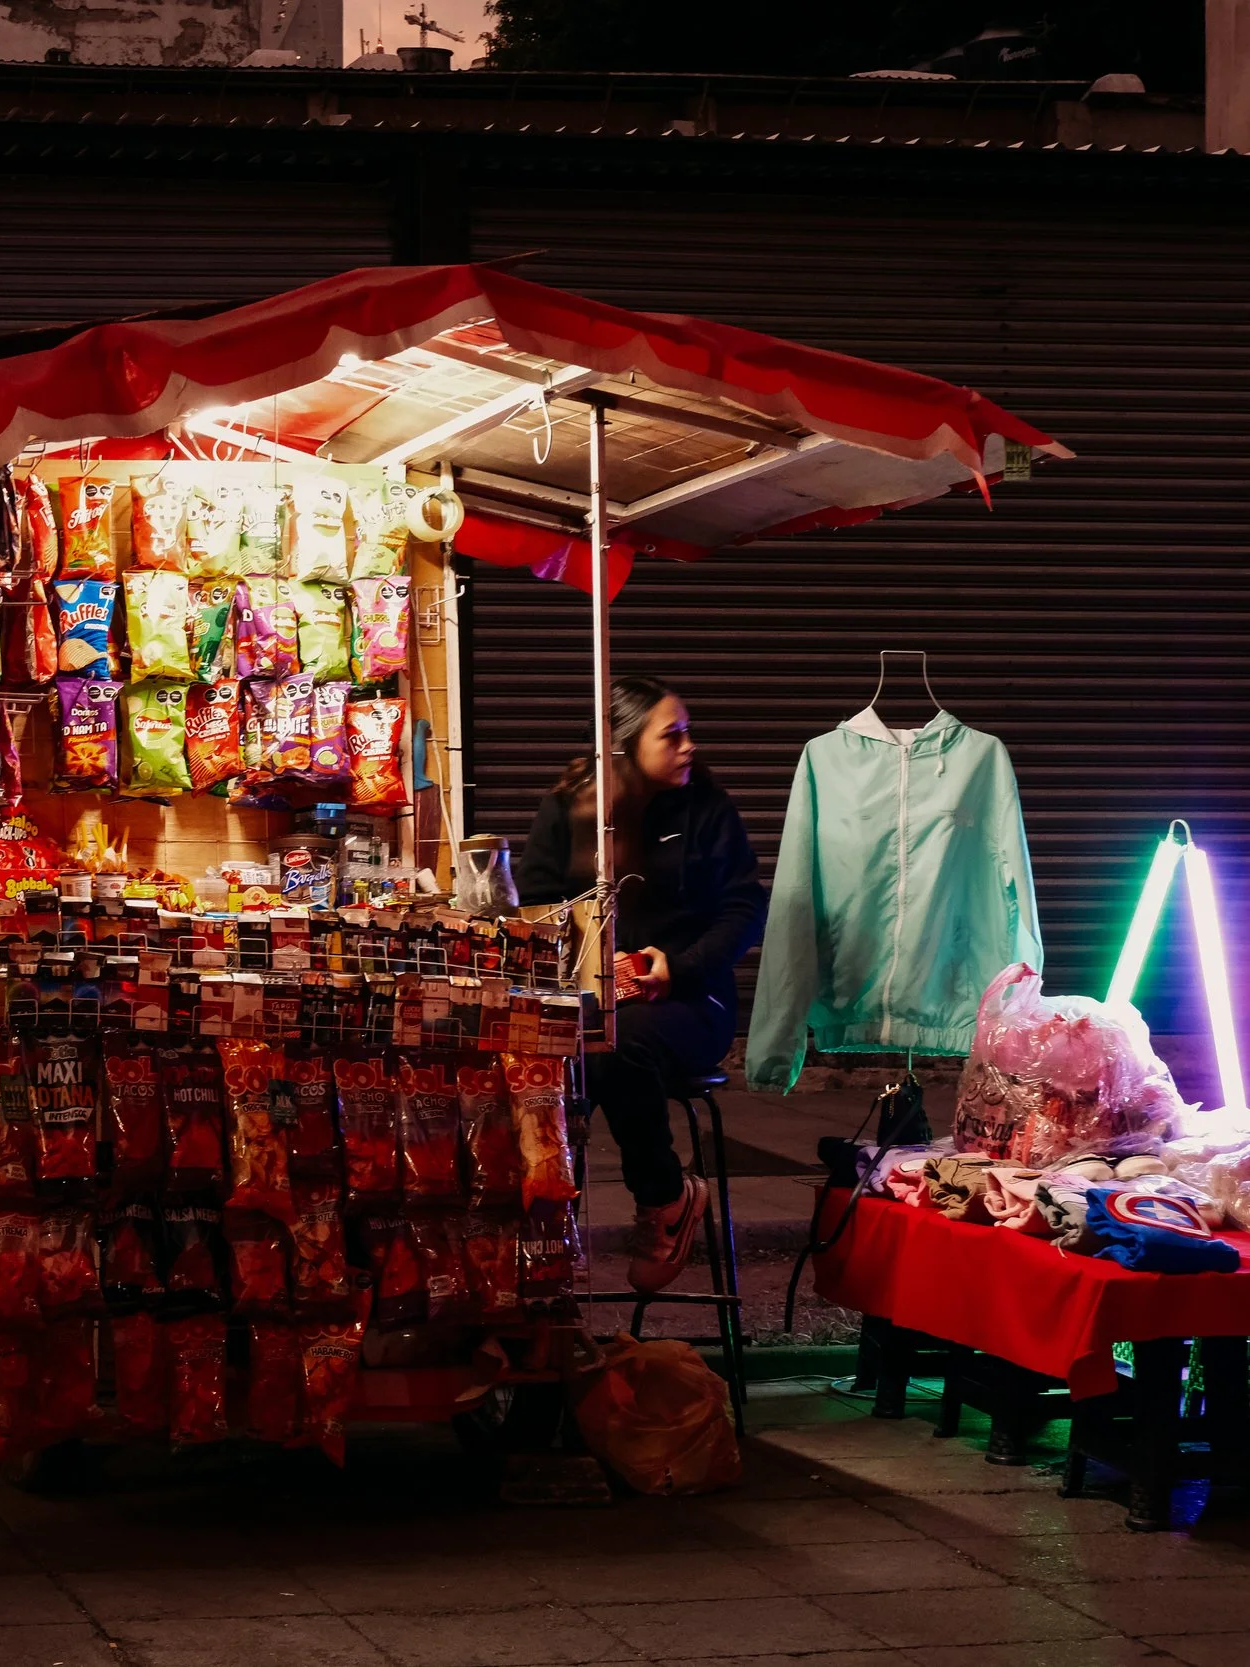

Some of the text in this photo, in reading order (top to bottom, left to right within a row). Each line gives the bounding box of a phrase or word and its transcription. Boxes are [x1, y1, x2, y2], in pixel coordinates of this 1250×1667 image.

[59, 603, 110, 635] Ruffles
[70, 708, 100, 720] Doritos
[134, 716, 172, 730] Sabritas
[185, 706, 225, 738] Ruffles
[36, 1061, 84, 1085] MAXI
[106, 1055, 160, 1084] SOL
[334, 1057, 391, 1091] SOL
[398, 1063, 457, 1099] SOL
[456, 1066, 500, 1096] SO
[506, 1060, 564, 1093] SOL
[27, 1085, 95, 1111] BOTANA
[116, 1085, 157, 1098] TACOS
[173, 1087, 193, 1103] HOT
[164, 1205, 195, 1223] SALSA
[545, 1239, 565, 1255] HOT
[310, 1345, 354, 1361] HABANERO
